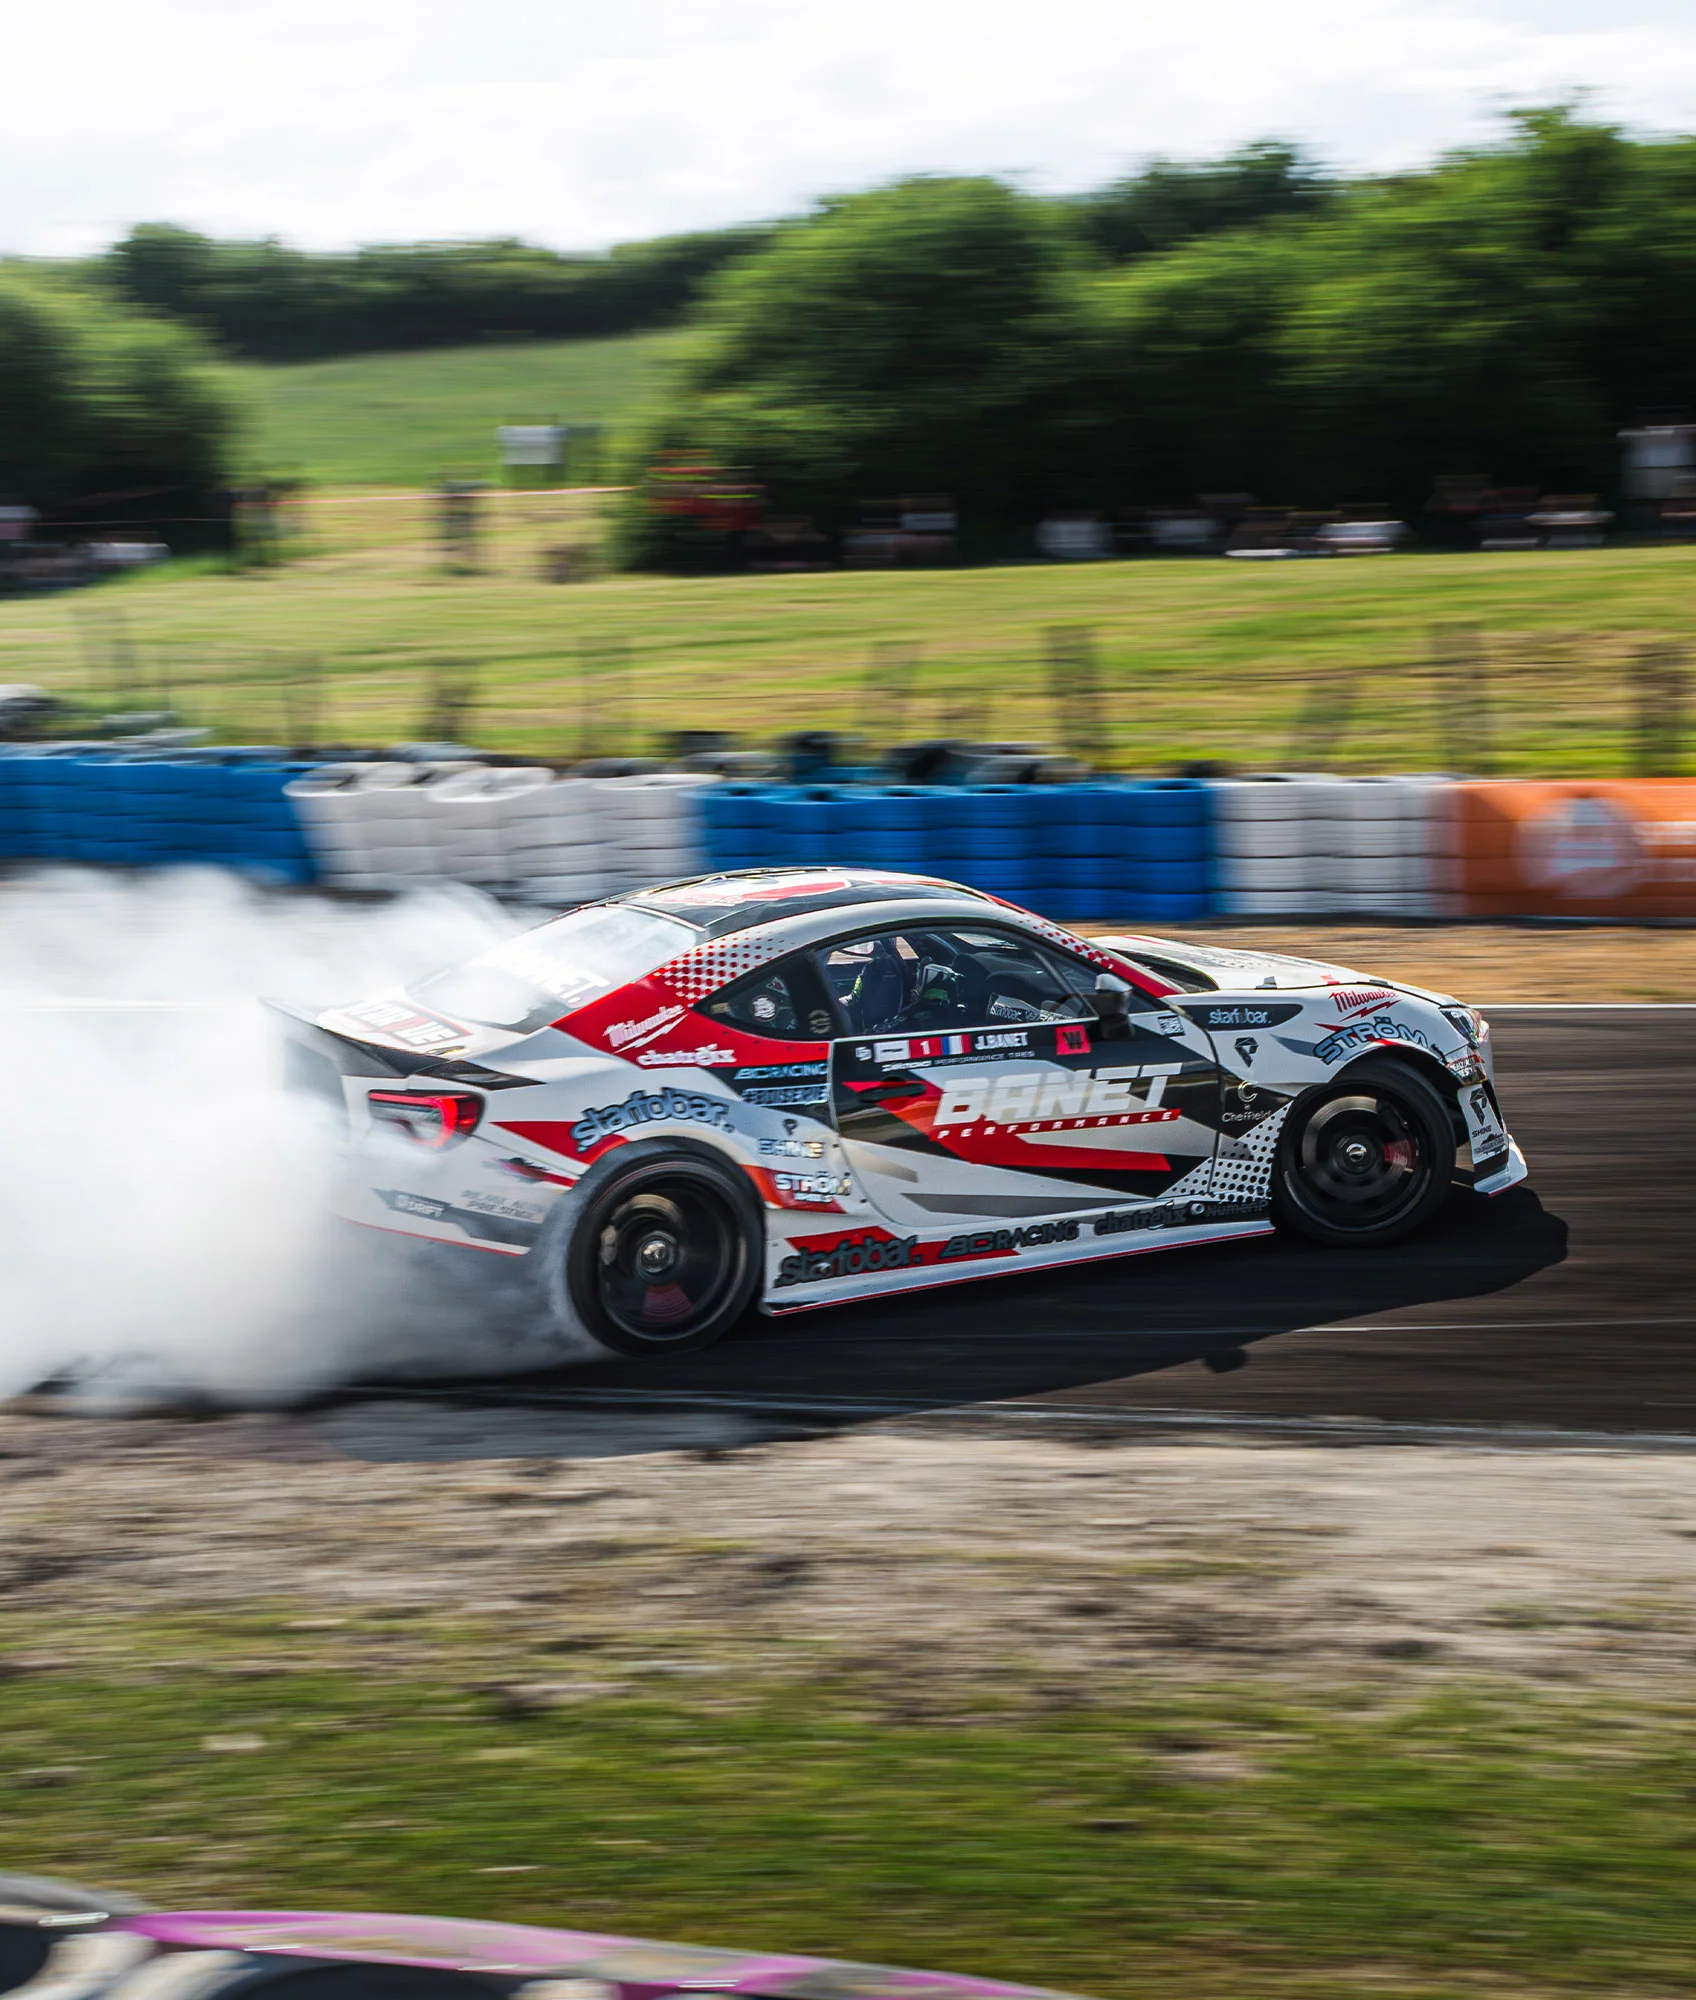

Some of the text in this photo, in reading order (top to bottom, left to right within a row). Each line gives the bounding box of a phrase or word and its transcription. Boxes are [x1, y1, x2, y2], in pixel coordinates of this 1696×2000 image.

[920, 1040, 931, 1055] 1
[1312, 1016, 1429, 1066] STRÖM
[933, 1062, 1183, 1125] BANET
[937, 1111, 1173, 1140] PERFORMANCE
[1472, 1125, 1492, 1138] SHINE
